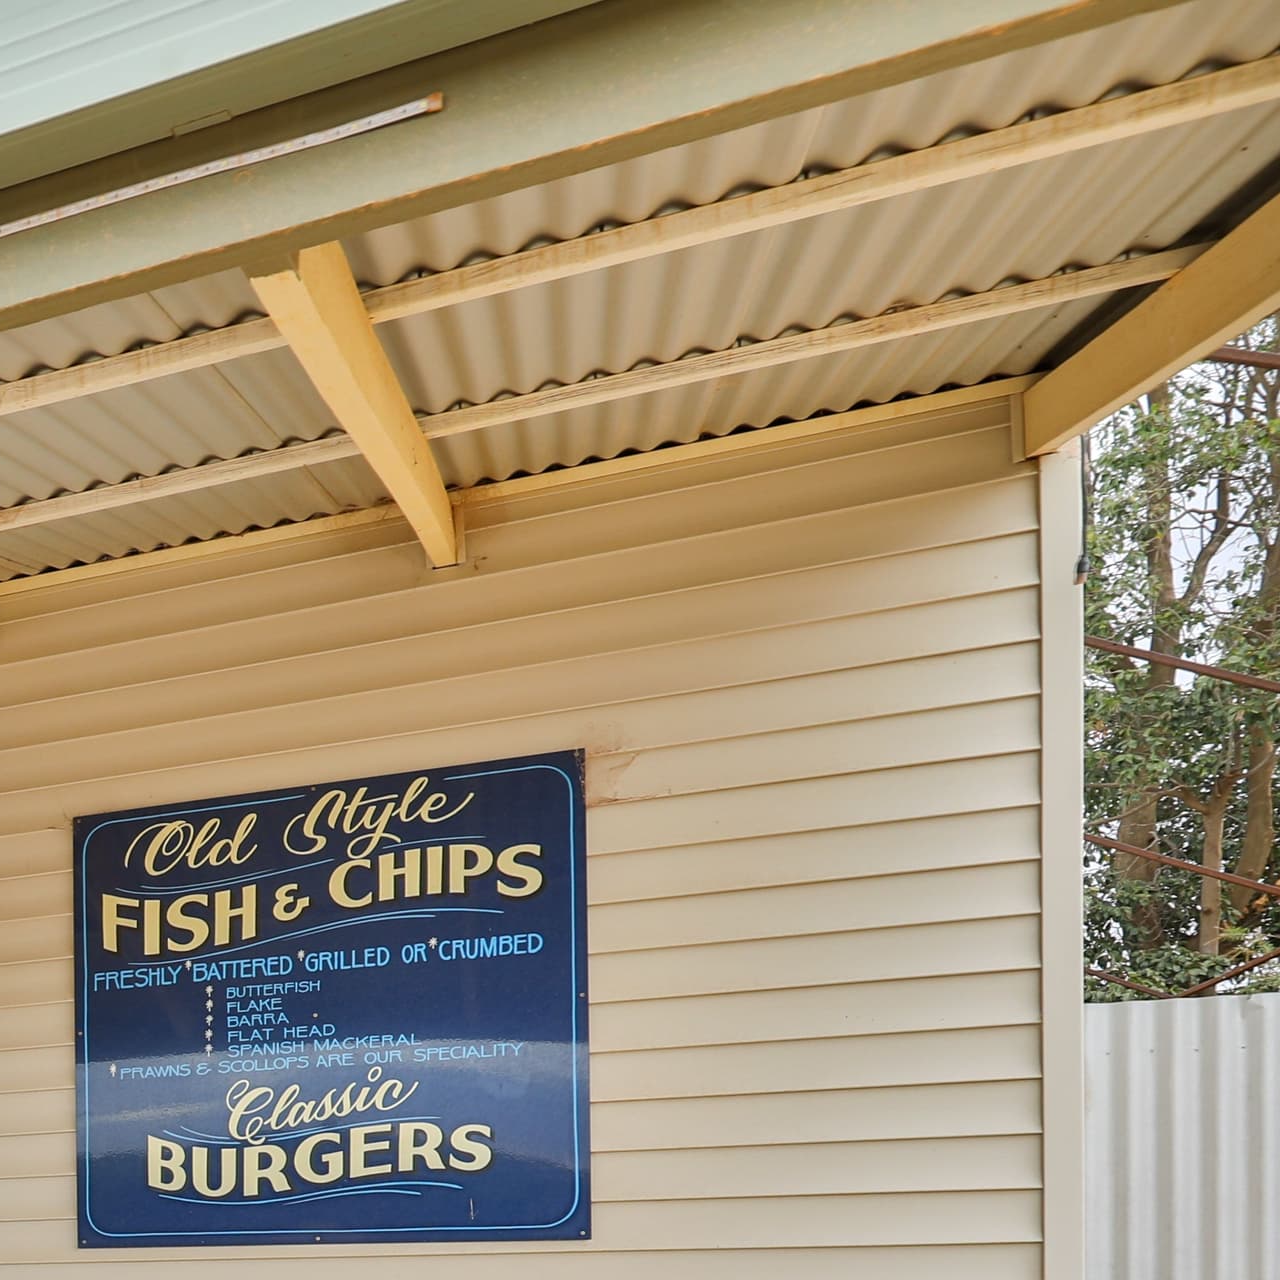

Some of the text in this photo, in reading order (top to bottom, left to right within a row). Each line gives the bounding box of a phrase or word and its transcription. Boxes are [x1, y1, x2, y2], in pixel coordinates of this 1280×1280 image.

[124, 776, 474, 877] Old Style
[101, 843, 544, 956] FISH & CHIPS
[94, 933, 544, 992] FRESHLY BATTERED GRILLED OR CRUMBED
[226, 980, 321, 999] BUTTERFISH
[226, 998, 282, 1013] FLAKE
[227, 1012, 289, 1028] BARRA
[227, 1023, 336, 1043] FLAT HEAD
[120, 1042, 524, 1080] PRAWNS & SCOLLOPS ARE OUR SPECIALITY
[227, 1033, 422, 1057] SPANISH MACKERAL
[226, 1066, 419, 1144] Classic
[147, 1122, 494, 1198] BURGERS
